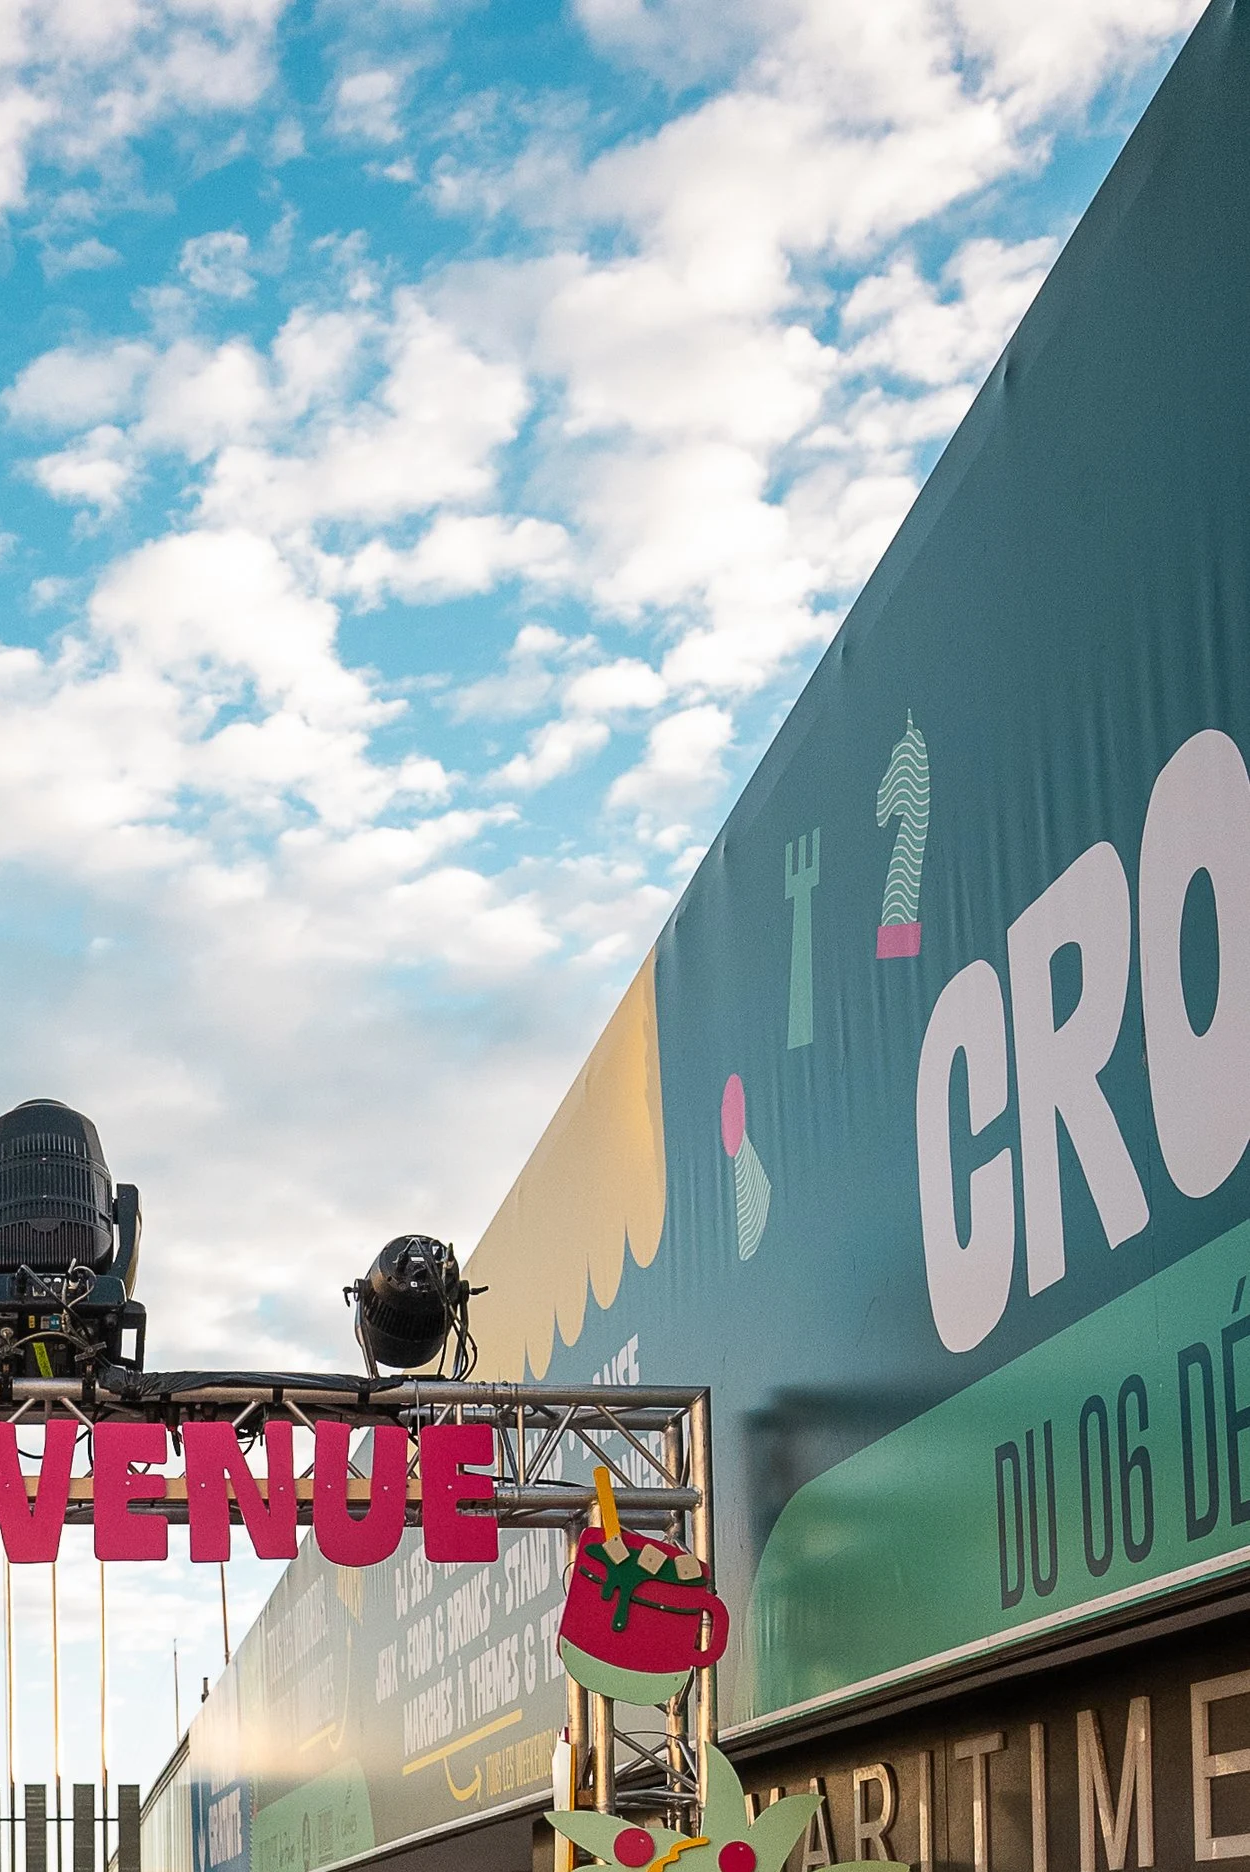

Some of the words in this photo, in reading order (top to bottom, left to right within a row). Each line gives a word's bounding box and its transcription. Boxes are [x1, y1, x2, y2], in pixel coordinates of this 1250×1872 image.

[994, 1419, 1058, 1612] DU
[1079, 1373, 1152, 1579] 06
[407, 1614, 432, 1683] FOOD
[447, 1566, 491, 1656] DRINKS
[504, 1528, 550, 1616] STAND
[403, 1666, 453, 1757] MARCHÉS
[457, 1655, 467, 1729] À
[469, 1635, 520, 1722] THÈMES
[523, 1623, 536, 1695] &
